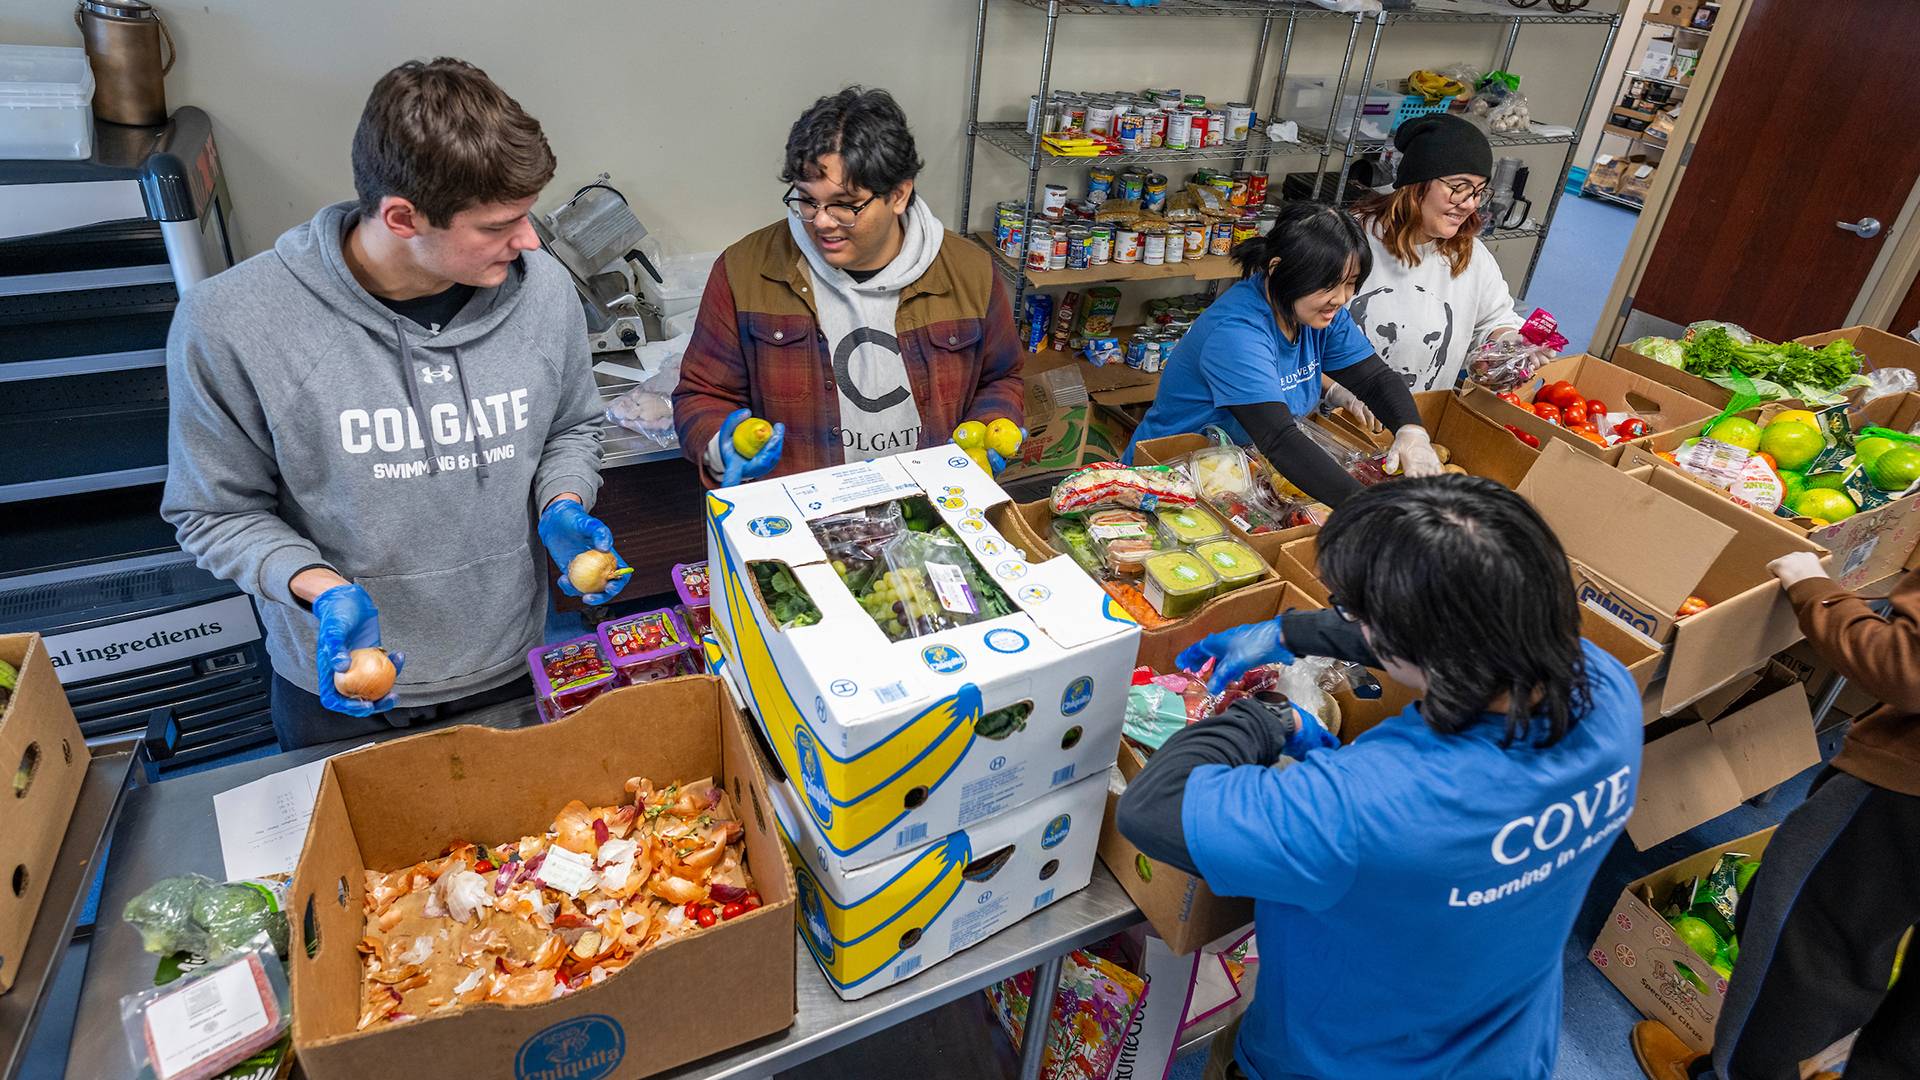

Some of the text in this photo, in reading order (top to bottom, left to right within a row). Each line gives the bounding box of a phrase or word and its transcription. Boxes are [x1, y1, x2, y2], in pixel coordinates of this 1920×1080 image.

[833, 326, 912, 413] C
[339, 388, 529, 453] COLGATE
[841, 425, 922, 452] OLGAT
[373, 456, 455, 479] SWIMMNG
[458, 455, 470, 470] &
[51, 620, 223, 669] al ingredients
[1491, 765, 1631, 865] COVE
[1449, 862, 1552, 907] Learning
[1556, 848, 1576, 869] in
[1640, 977, 1704, 1041] Specialty Citrus
